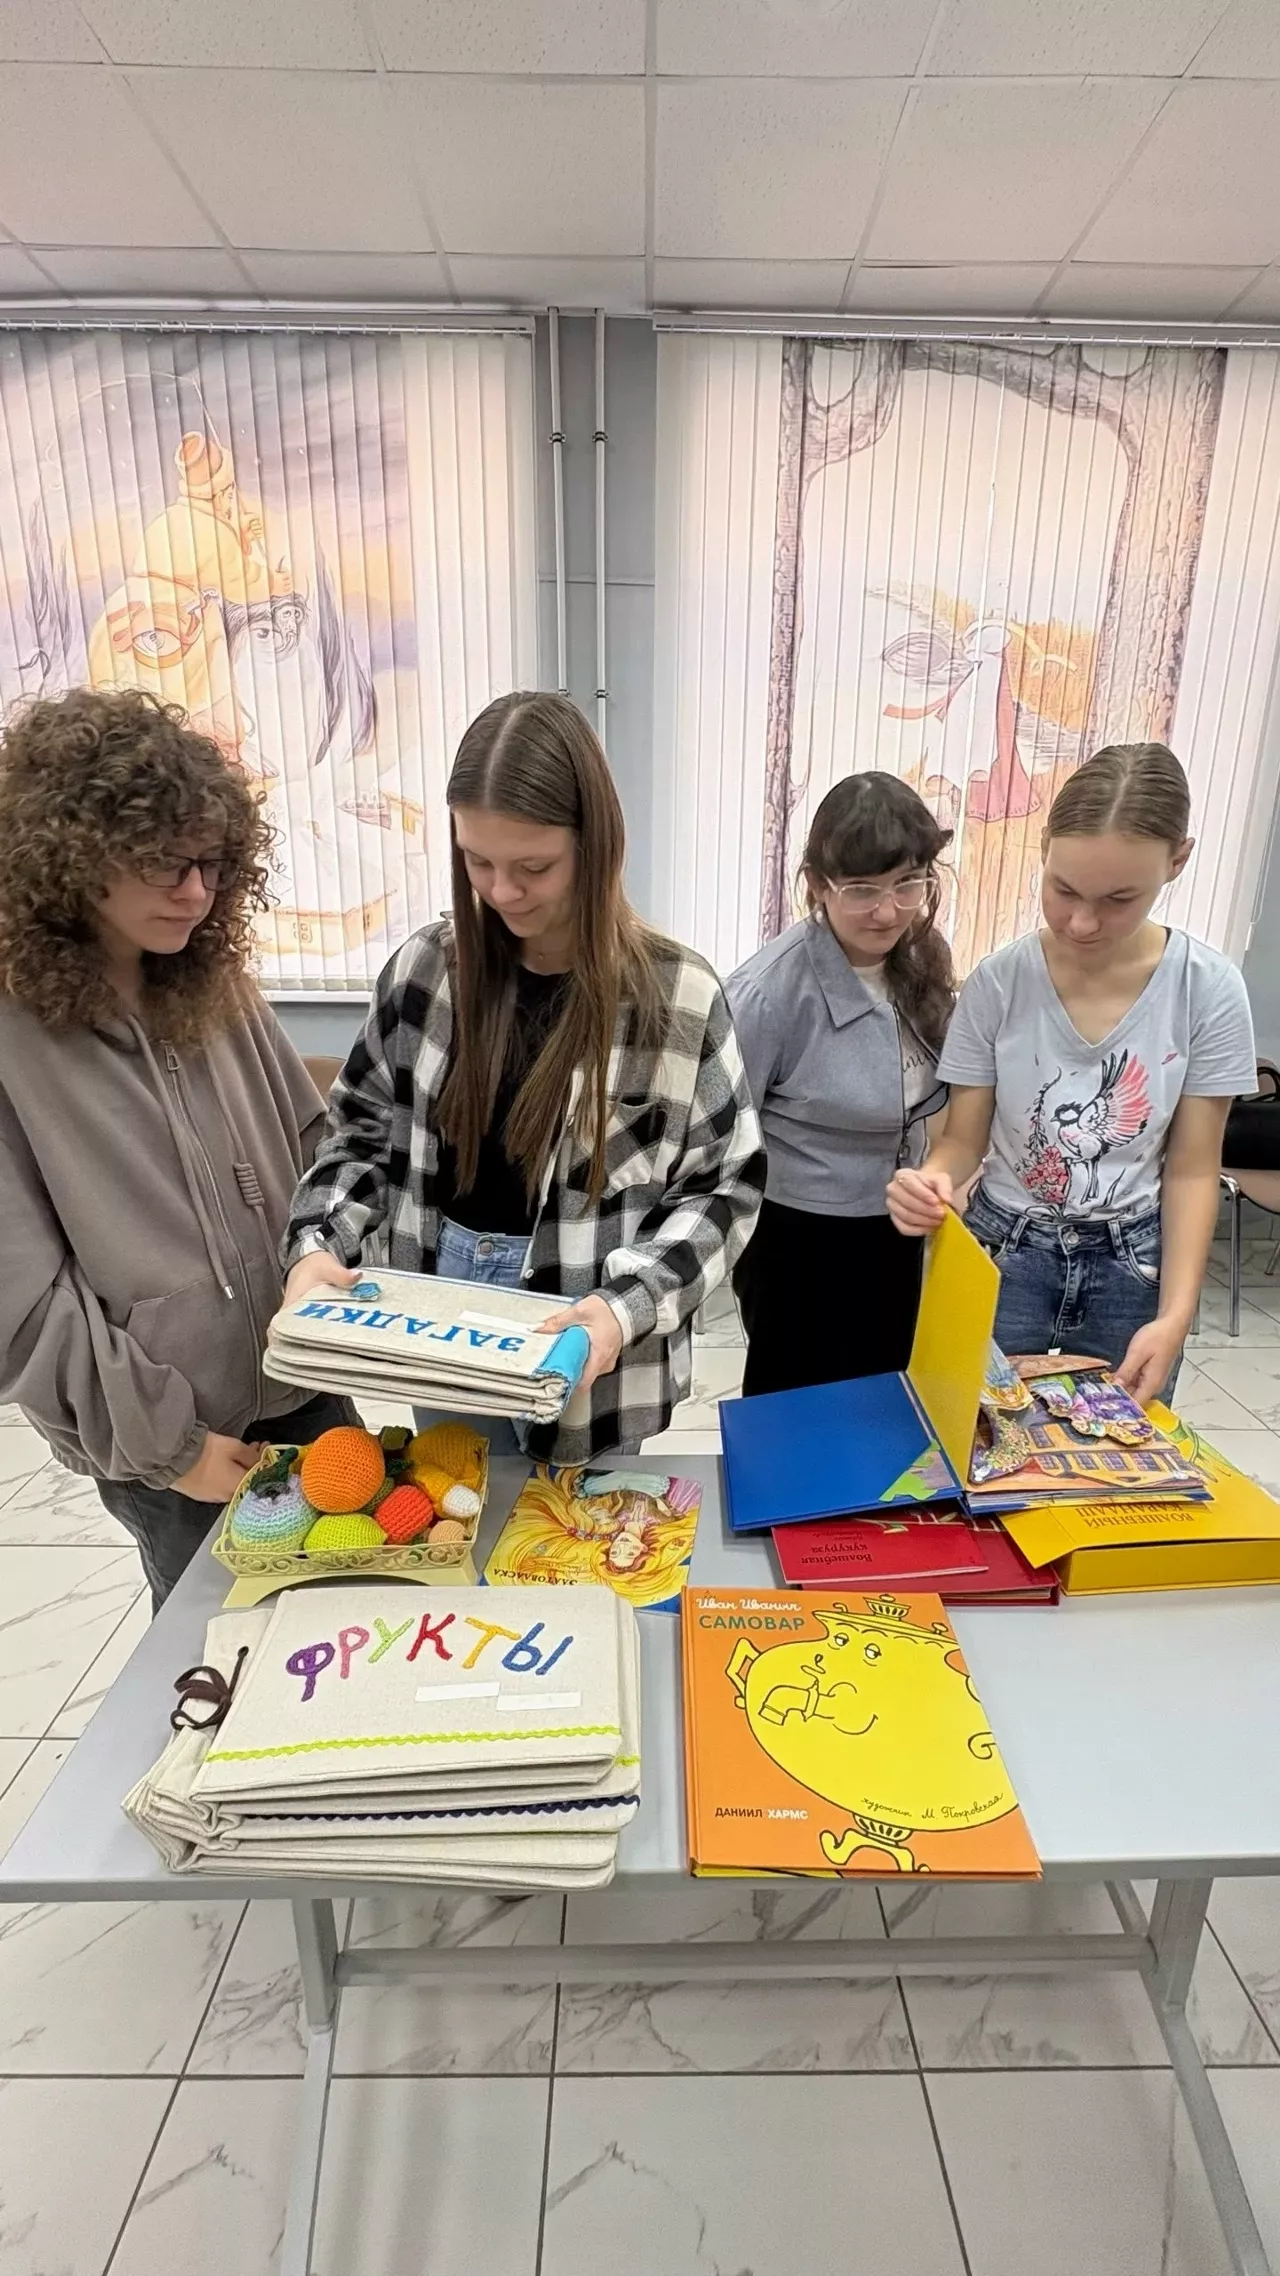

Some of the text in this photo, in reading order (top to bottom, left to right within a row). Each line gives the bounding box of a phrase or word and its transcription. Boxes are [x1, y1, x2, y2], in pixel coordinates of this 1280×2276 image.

[293, 1302, 527, 1353] ЗАГАДКИ
[1075, 1503, 1183, 1517] КАРАНДАШ
[1083, 1513, 1195, 1529] ВОЛШЕБНЫЙ
[811, 1543, 868, 1555] кукуруза
[801, 1553, 873, 1565] Волшебная
[493, 1568, 578, 1586] ЗЛАТОВЛАСКА
[695, 1598, 737, 1611] Иван
[698, 1615, 805, 1631] САМОВАР
[285, 1612, 574, 1702] ФРУКТЫ
[715, 1807, 808, 1820] ДАНИИЛ ХАРМС
[861, 1797, 913, 1818] художник
[941, 1793, 1004, 1822] Покровская
